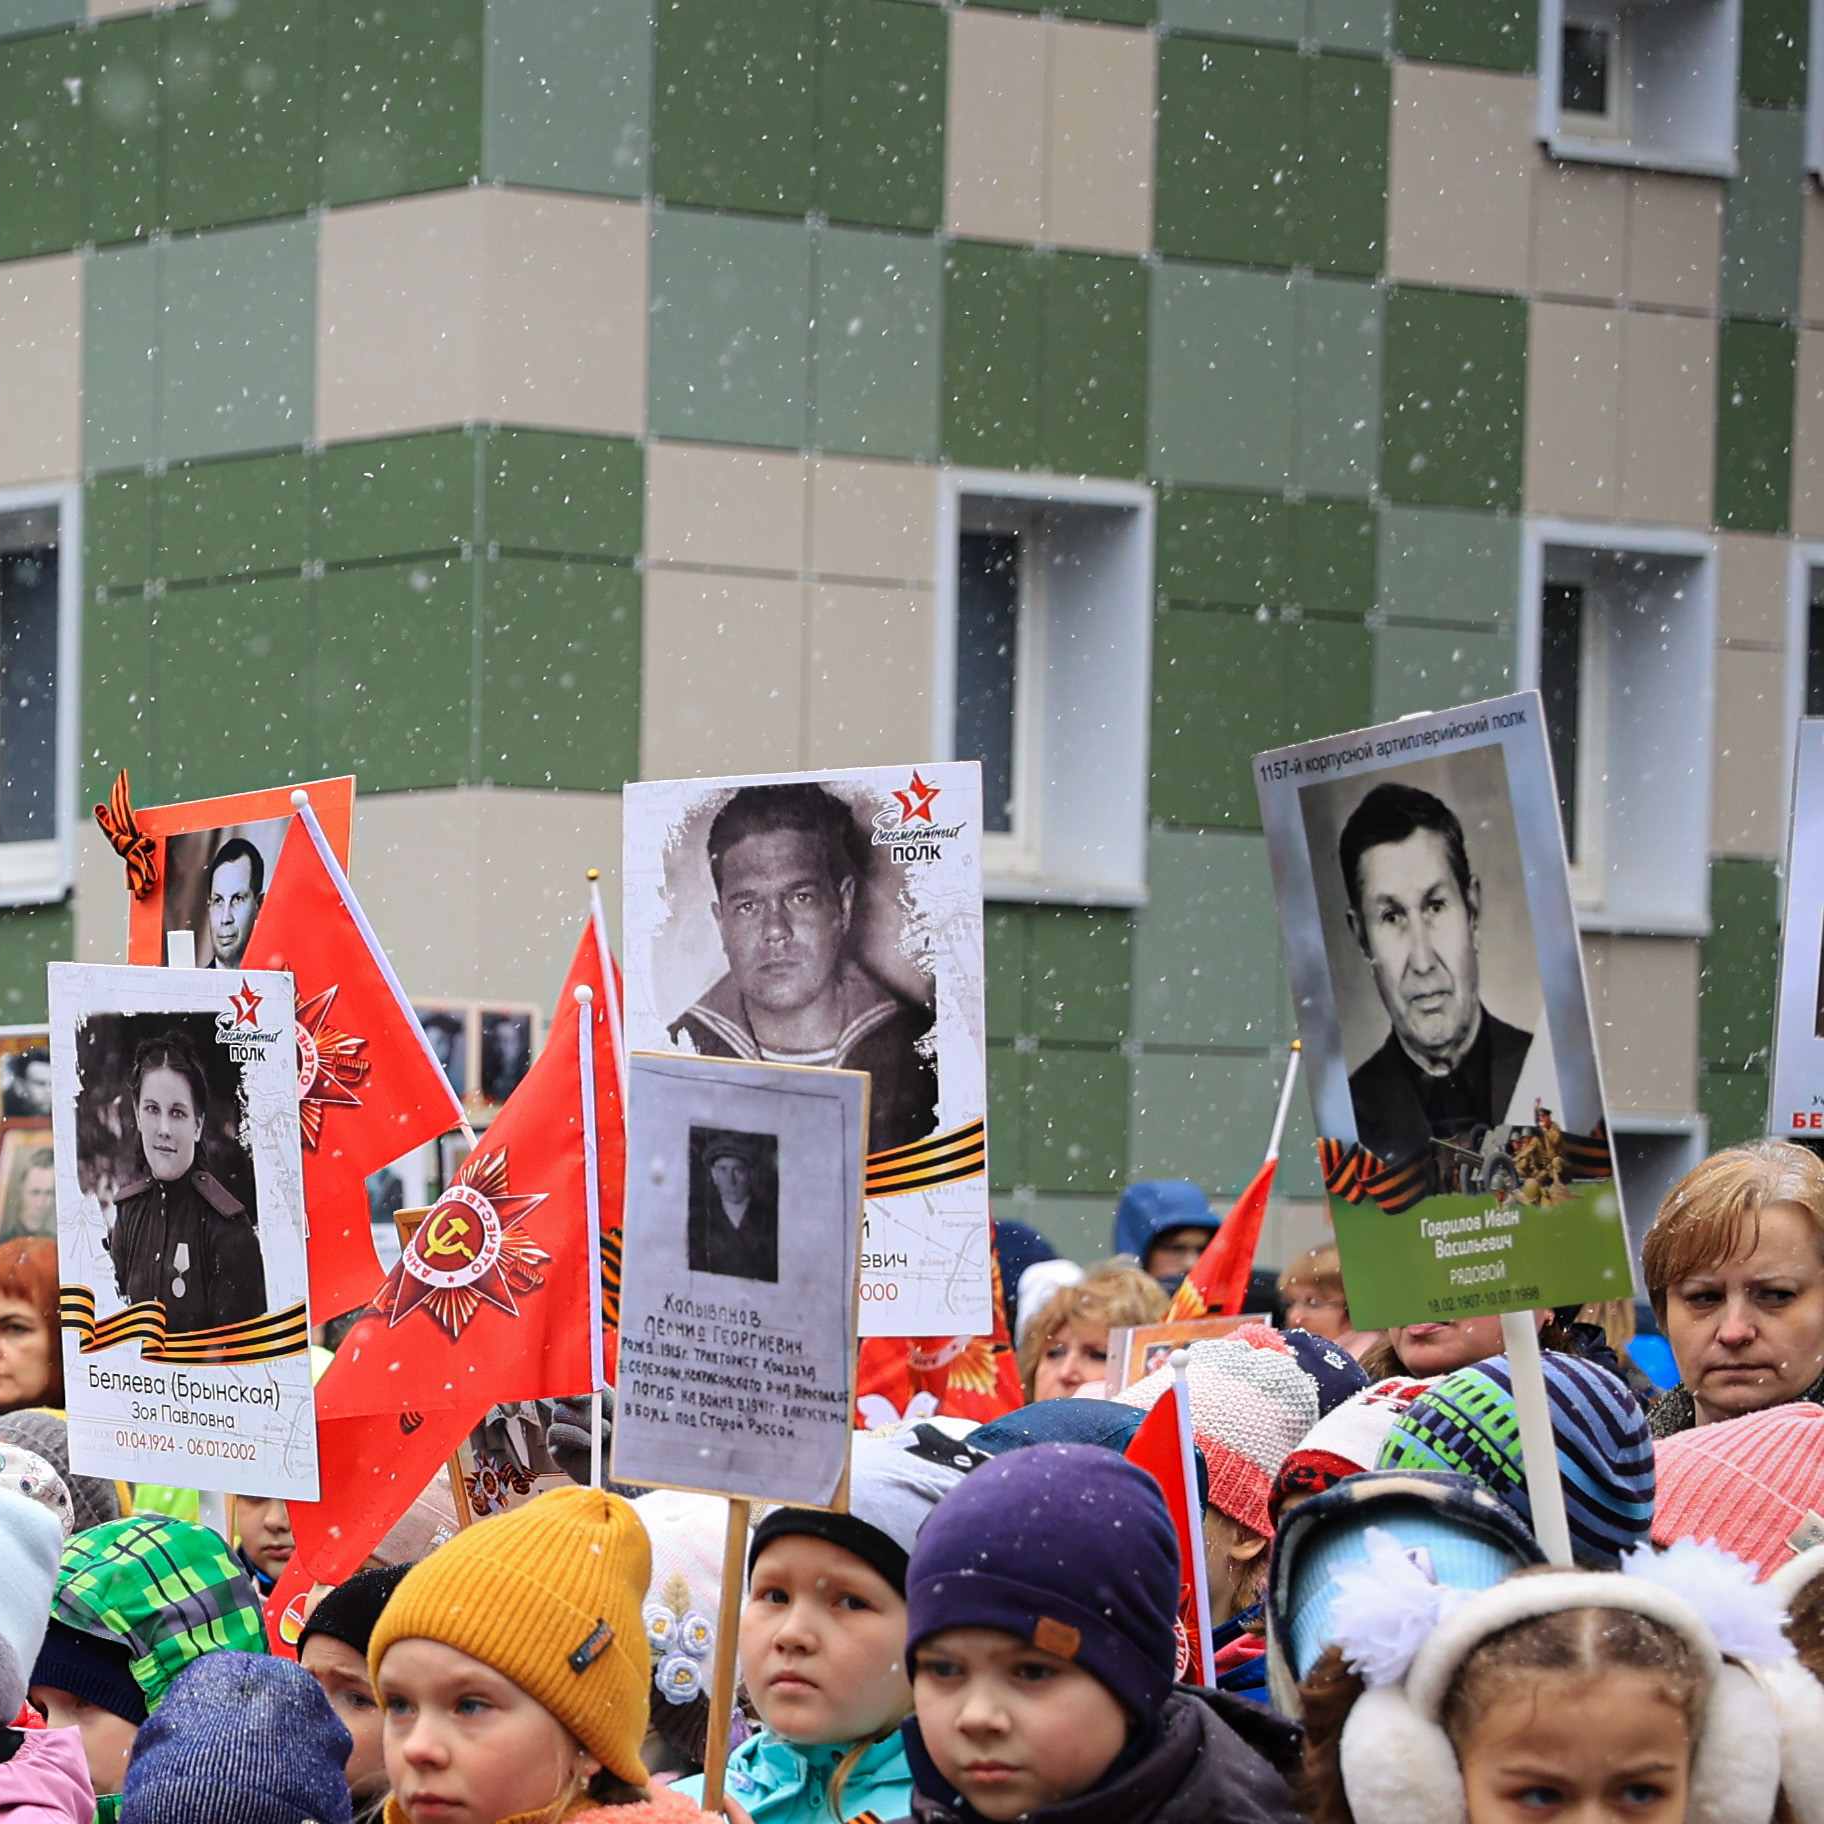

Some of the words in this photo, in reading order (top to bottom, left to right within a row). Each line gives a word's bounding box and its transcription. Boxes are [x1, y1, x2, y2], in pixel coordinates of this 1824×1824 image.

[1259, 758, 1303, 783] 1157-й
[1305, 741, 1374, 774] корпусной
[1376, 714, 1489, 759] артиллерийский
[1491, 708, 1527, 729] полк
[1420, 1215, 1482, 1239] Гаврилов
[1484, 1208, 1520, 1229] Иван
[1435, 1234, 1513, 1259] Васильевич
[1449, 1259, 1506, 1286] РЯДОВОЙ
[88, 1364, 166, 1396] Беляева
[171, 1371, 280, 1411] (Брынская)
[131, 1401, 158, 1421] Зоя
[161, 1404, 235, 1429] Павловна
[116, 1430, 175, 1453] 01.04.1924
[187, 1437, 257, 1461] 06.01.2002
